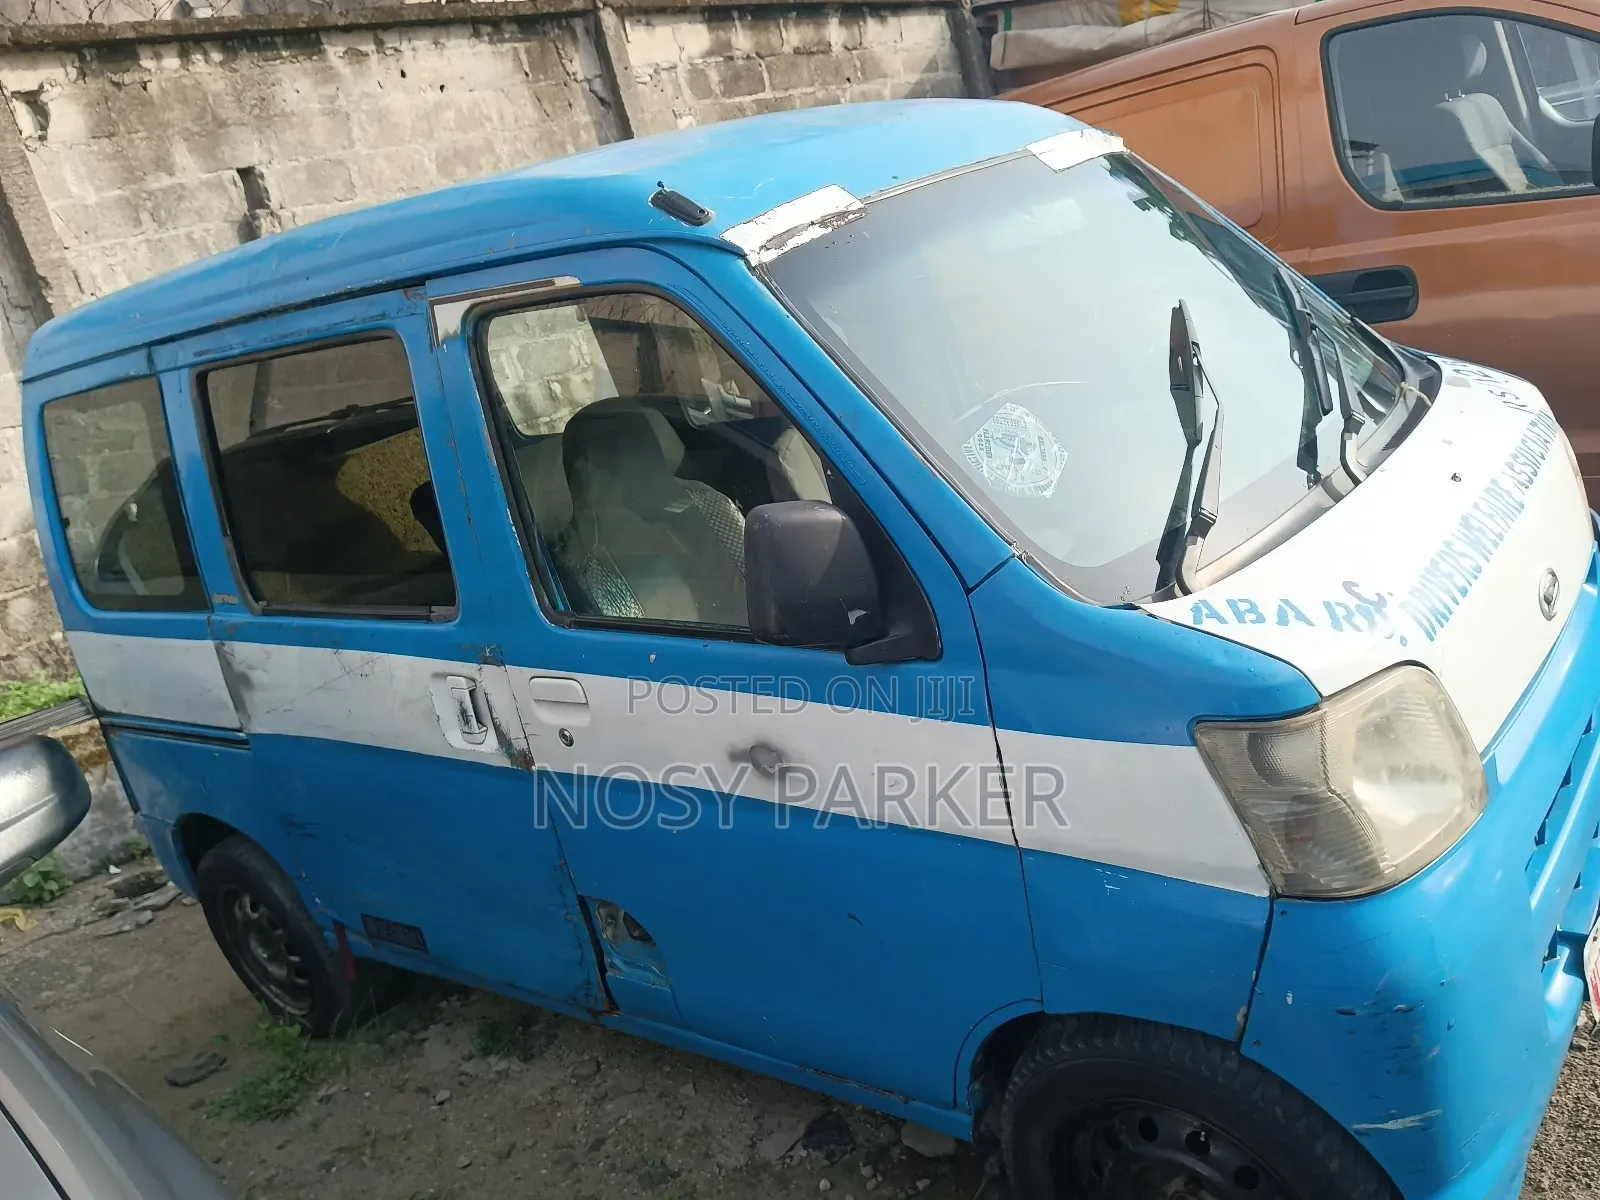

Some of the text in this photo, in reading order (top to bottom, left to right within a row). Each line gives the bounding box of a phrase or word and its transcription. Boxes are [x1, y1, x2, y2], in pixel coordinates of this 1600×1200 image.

[1190, 598, 1316, 627] ABA
[1399, 540, 1483, 642] DRIVERS
[1453, 478, 1525, 563] WELFARE
